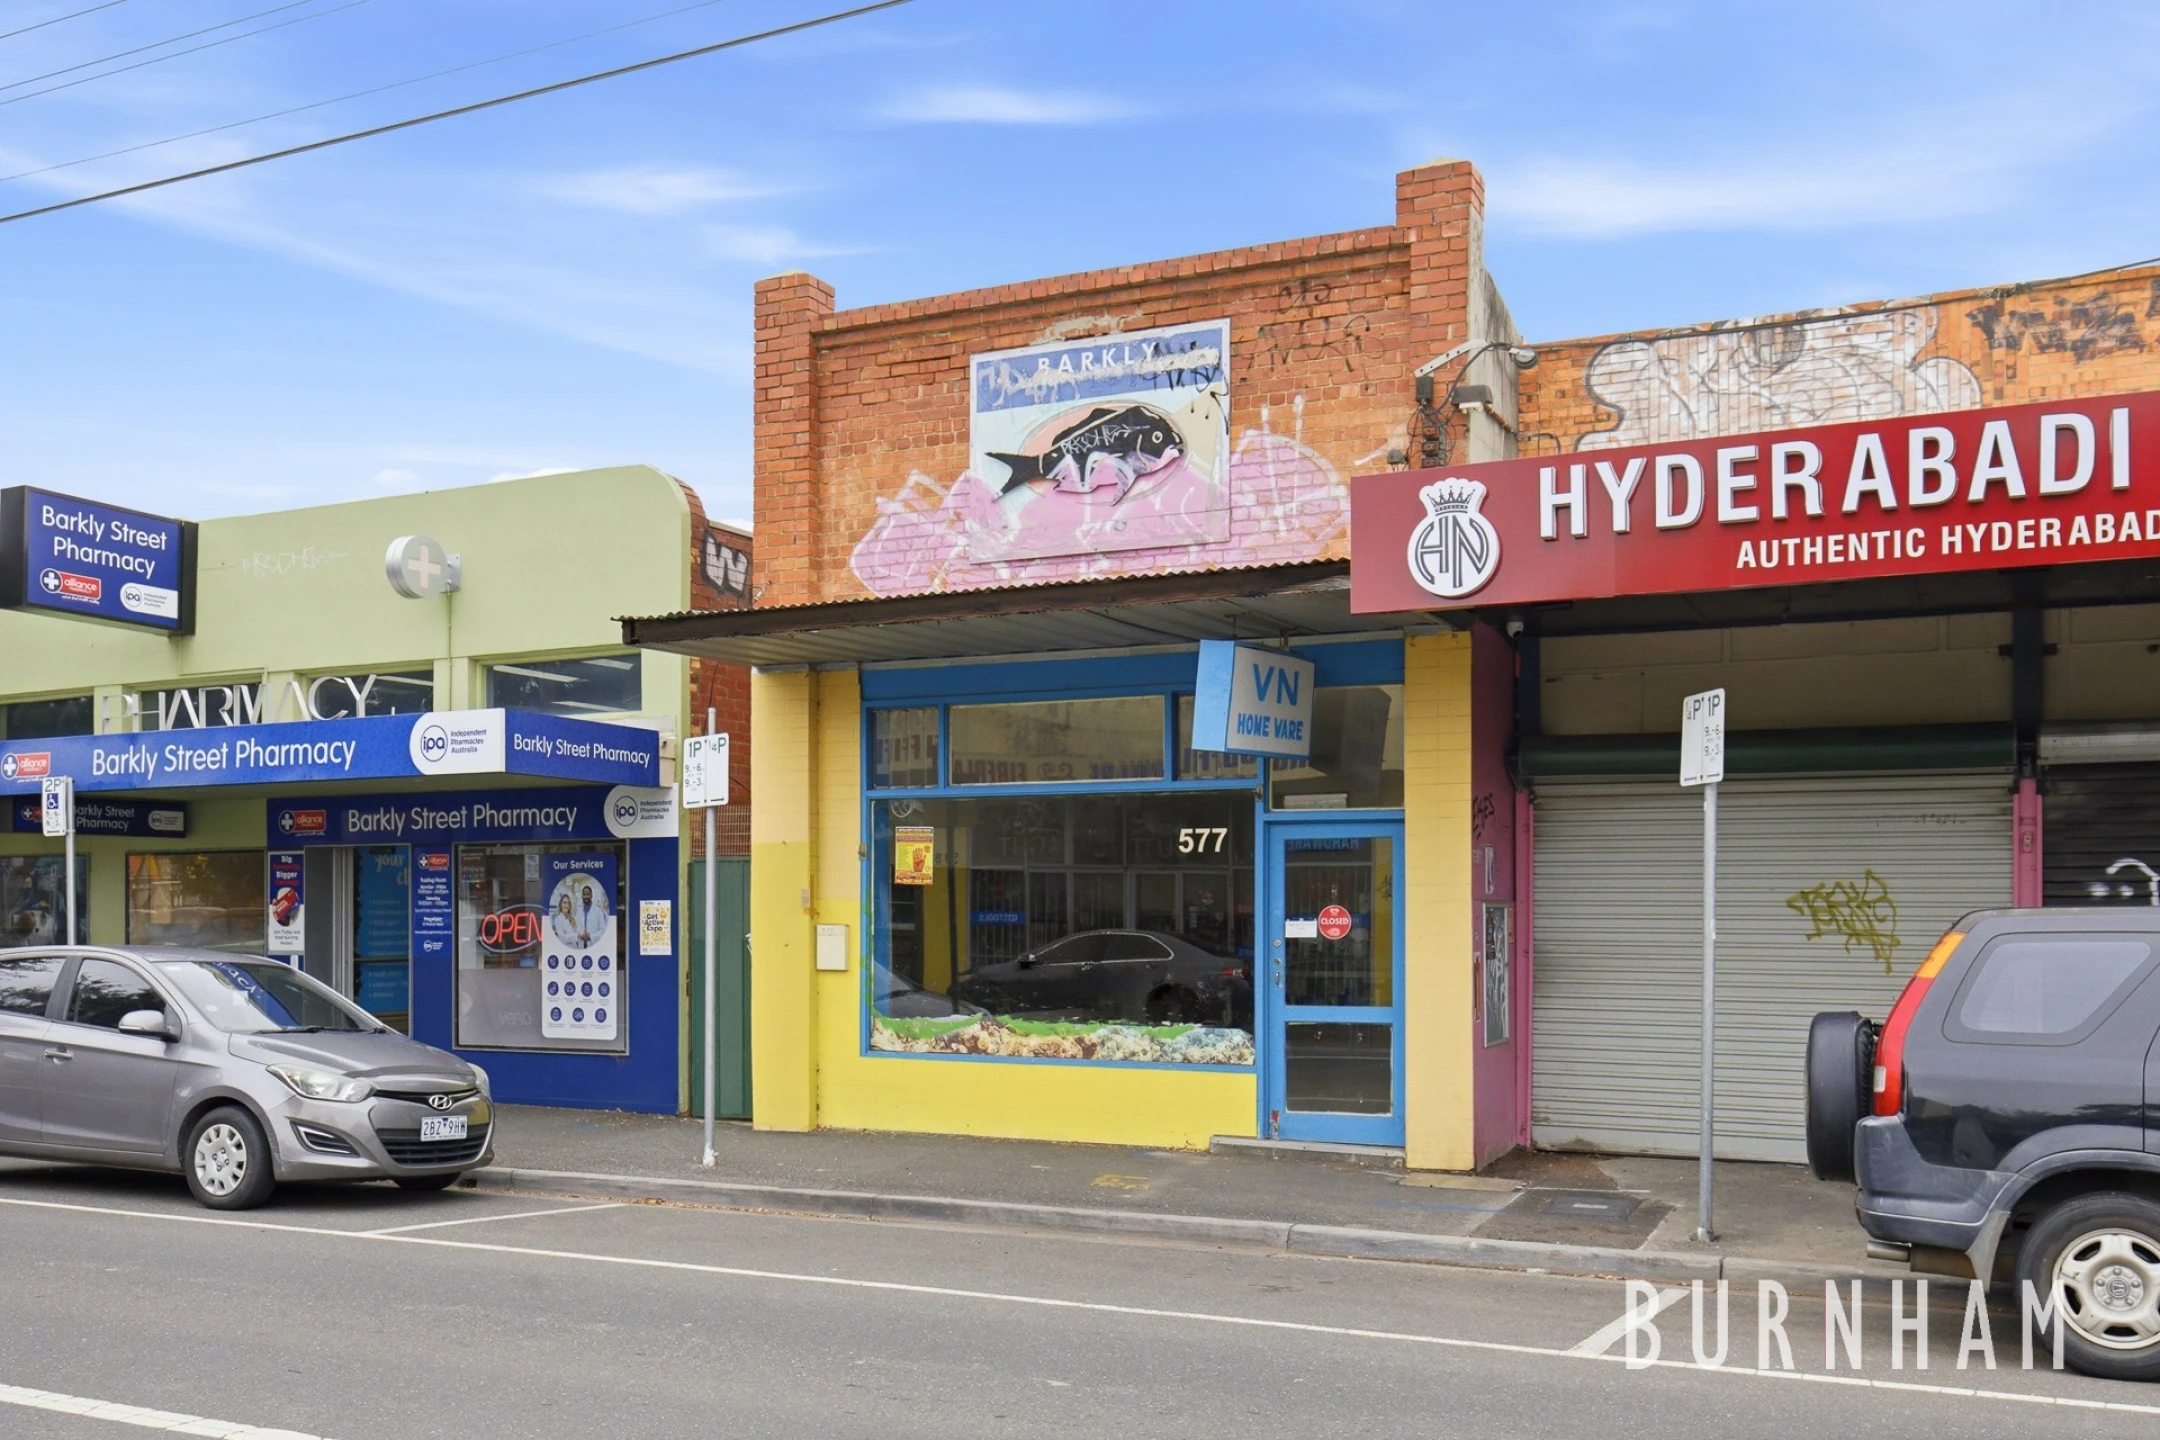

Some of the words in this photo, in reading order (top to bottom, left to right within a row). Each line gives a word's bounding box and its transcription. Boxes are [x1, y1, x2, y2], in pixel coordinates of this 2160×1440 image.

[1038, 341, 1158, 374] BARKLY
[1539, 407, 2131, 541] HYDERABADI
[42, 504, 105, 542] Barkly
[110, 521, 167, 550] Street
[53, 536, 155, 580] Pharmacy
[1736, 527, 1926, 569] AUTHENTIC
[1253, 663, 1299, 706] VN
[102, 674, 378, 735] PHARMACY
[451, 728, 487, 738] Independent
[1237, 712, 1270, 737] HOME
[423, 736, 445, 752] ipa
[451, 736, 484, 746] Pharmacies
[451, 745, 478, 754] Australia
[514, 733, 552, 758] Barkly
[556, 738, 590, 758] Street
[593, 741, 650, 769] Pharmacy
[689, 741, 702, 757] 1P
[92, 745, 158, 781] Barkly
[163, 742, 229, 772] Street
[235, 738, 356, 771] Pharmacy
[45, 779, 61, 792] 2P
[74, 805, 103, 820] arkly
[106, 805, 135, 818] Street
[615, 805, 637, 819] ipa
[640, 799, 673, 808] Independent
[76, 817, 130, 832] Pharmacy
[349, 806, 406, 837] Barkly
[411, 804, 467, 830] Street
[473, 802, 577, 832] Pharmacy
[1178, 828, 1228, 853] 577
[553, 861, 568, 870] Our
[570, 860, 604, 869] Services
[482, 912, 542, 944] OPEN
[1320, 917, 1349, 925] CLOSED
